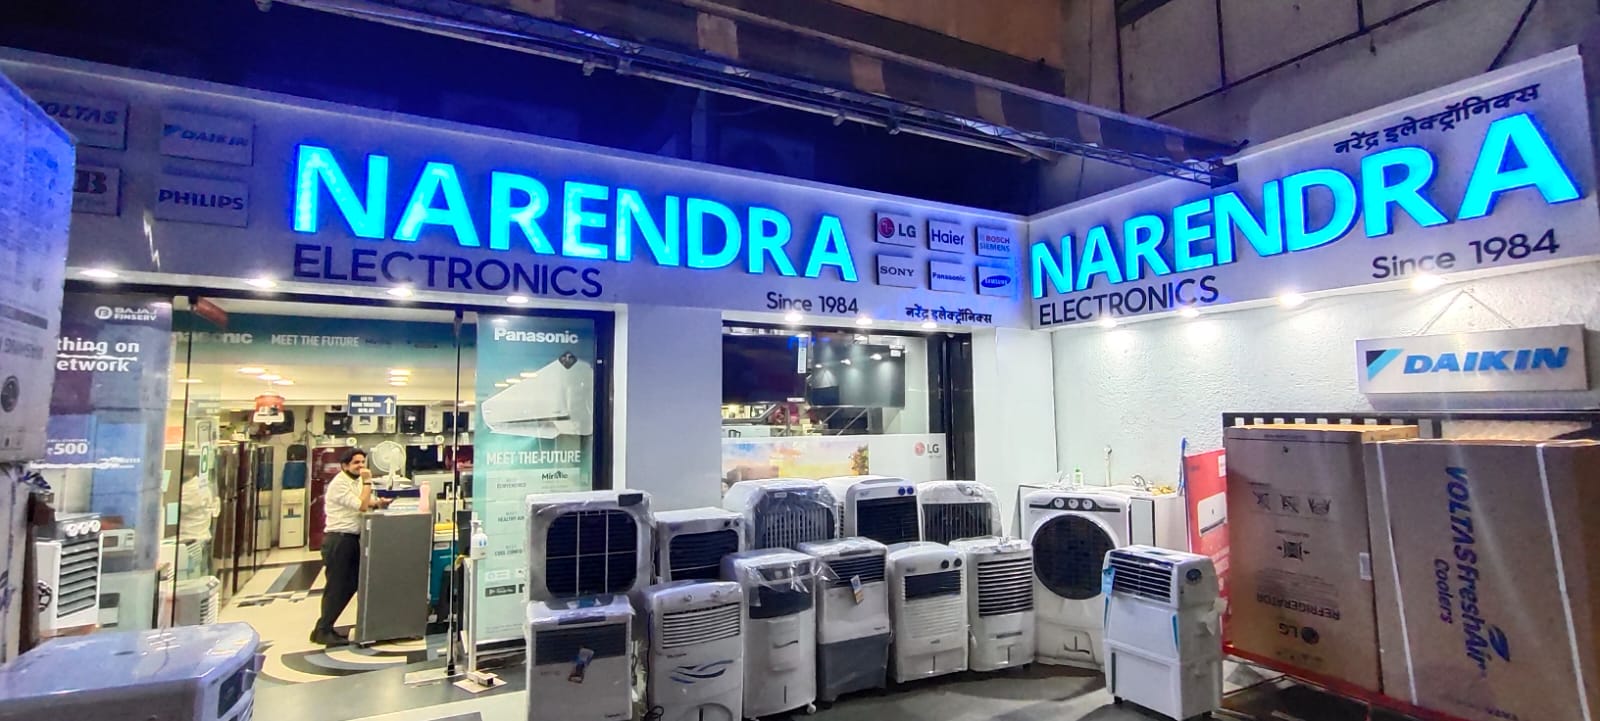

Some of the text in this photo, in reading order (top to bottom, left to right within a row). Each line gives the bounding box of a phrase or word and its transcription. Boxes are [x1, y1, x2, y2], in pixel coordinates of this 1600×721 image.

[38, 101, 120, 124] OLTAS
[1336, 83, 1540, 155] नरेंद्र इलेक्ट्रॉनिक्स
[181, 128, 248, 147] DAIKIN
[158, 188, 244, 211] PHILIPS
[1032, 112, 1581, 301] NARENDRA
[293, 144, 858, 283] NARENDRA
[899, 223, 916, 239] LG
[932, 229, 964, 246] Haier
[986, 234, 1010, 245] BOSCH
[980, 243, 1010, 252] SIEMENS
[1372, 228, 1561, 279] Since 1984
[293, 243, 603, 298] ELECTRONICS
[880, 266, 915, 278] SONY
[932, 272, 966, 282] Panasonic
[766, 291, 859, 315] Since 1984
[1039, 276, 1219, 325] ELECTRONICS
[114, 307, 157, 315] BAJAJ
[271, 334, 298, 345] MEET
[301, 335, 320, 345] THE
[322, 336, 359, 347] FUTURE
[494, 327, 579, 344] Panasonic
[115, 342, 140, 353] on
[1404, 344, 1570, 375] DAIKIN
[927, 443, 939, 454] LG
[486, 451, 581, 465] MEET THE FUTURE
[1432, 558, 1454, 625] Coolers
[1256, 592, 1341, 620] REFRIGERATOR
[1278, 622, 1299, 639] LG
